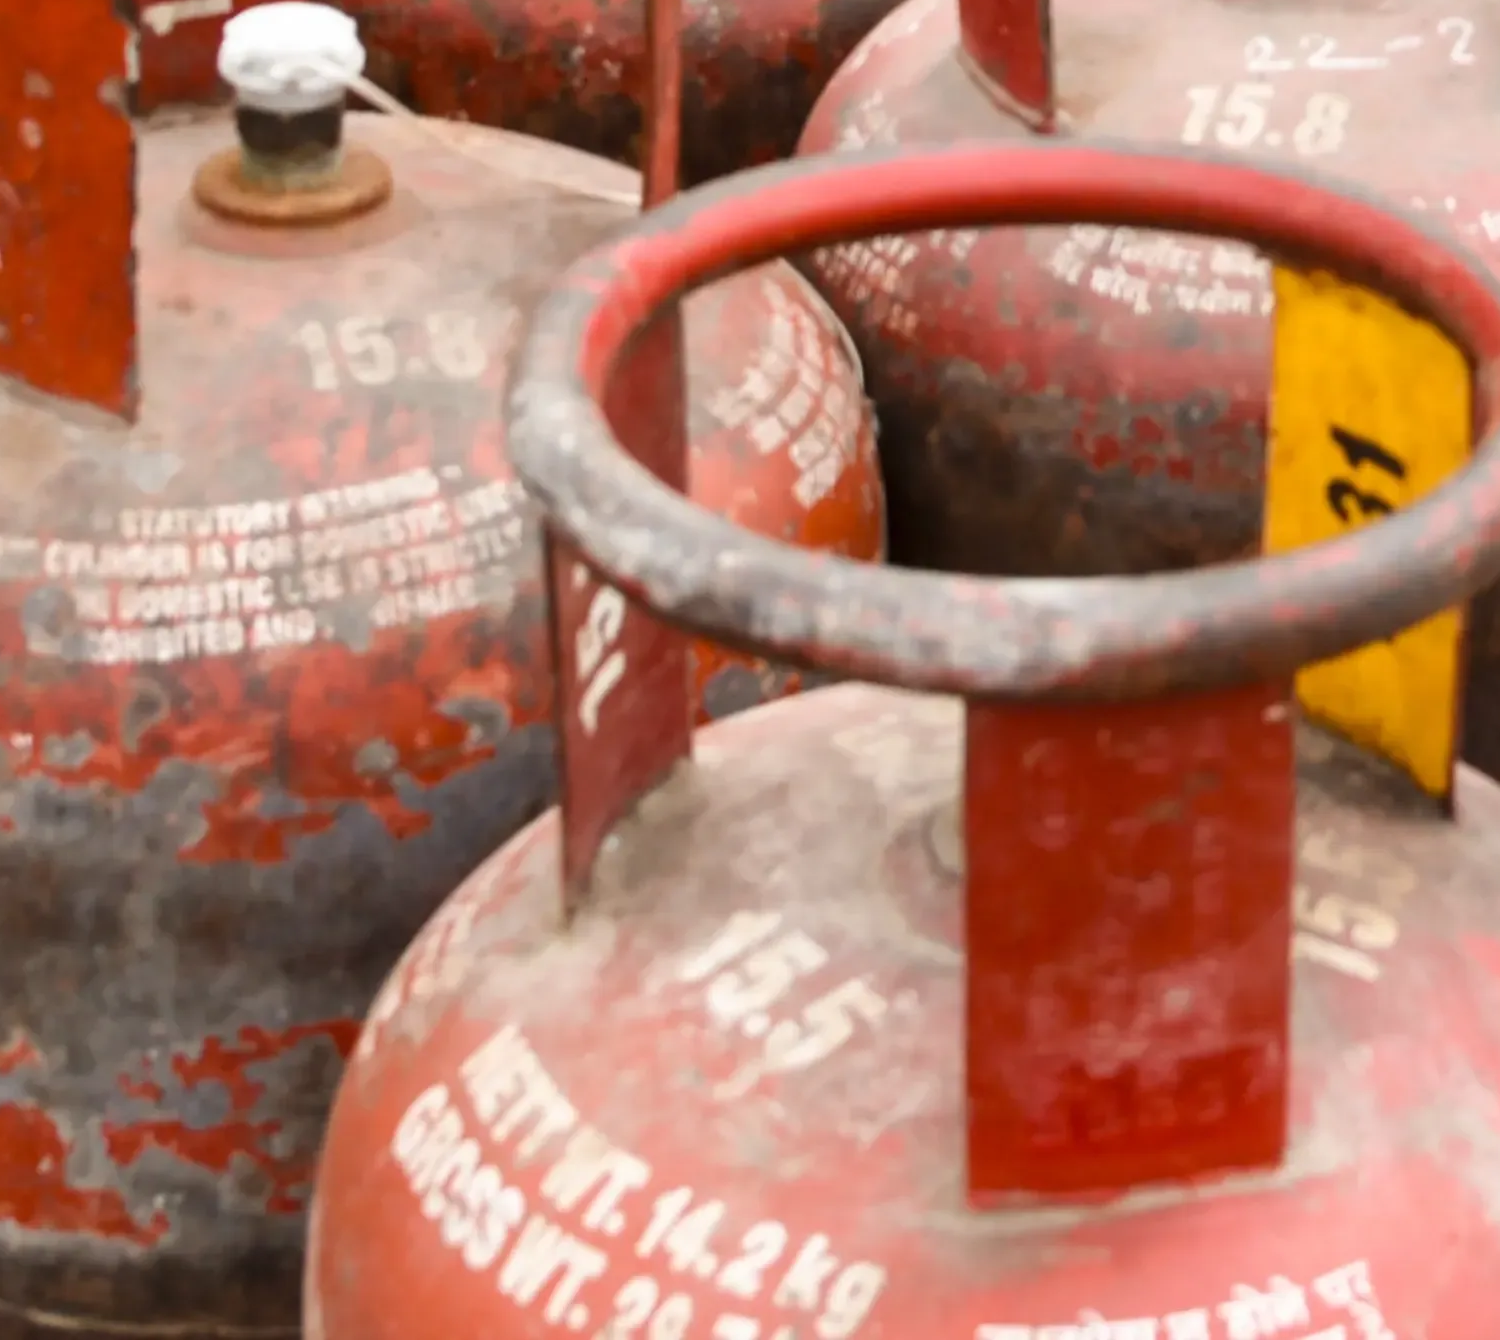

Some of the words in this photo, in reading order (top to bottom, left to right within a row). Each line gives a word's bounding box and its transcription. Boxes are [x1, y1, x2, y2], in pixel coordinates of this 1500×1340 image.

[1179, 85, 1353, 157] 15.8
[675, 908, 890, 1101] 15.5
[636, 1186, 789, 1302] 14.2
[772, 1231, 890, 1338] kg
